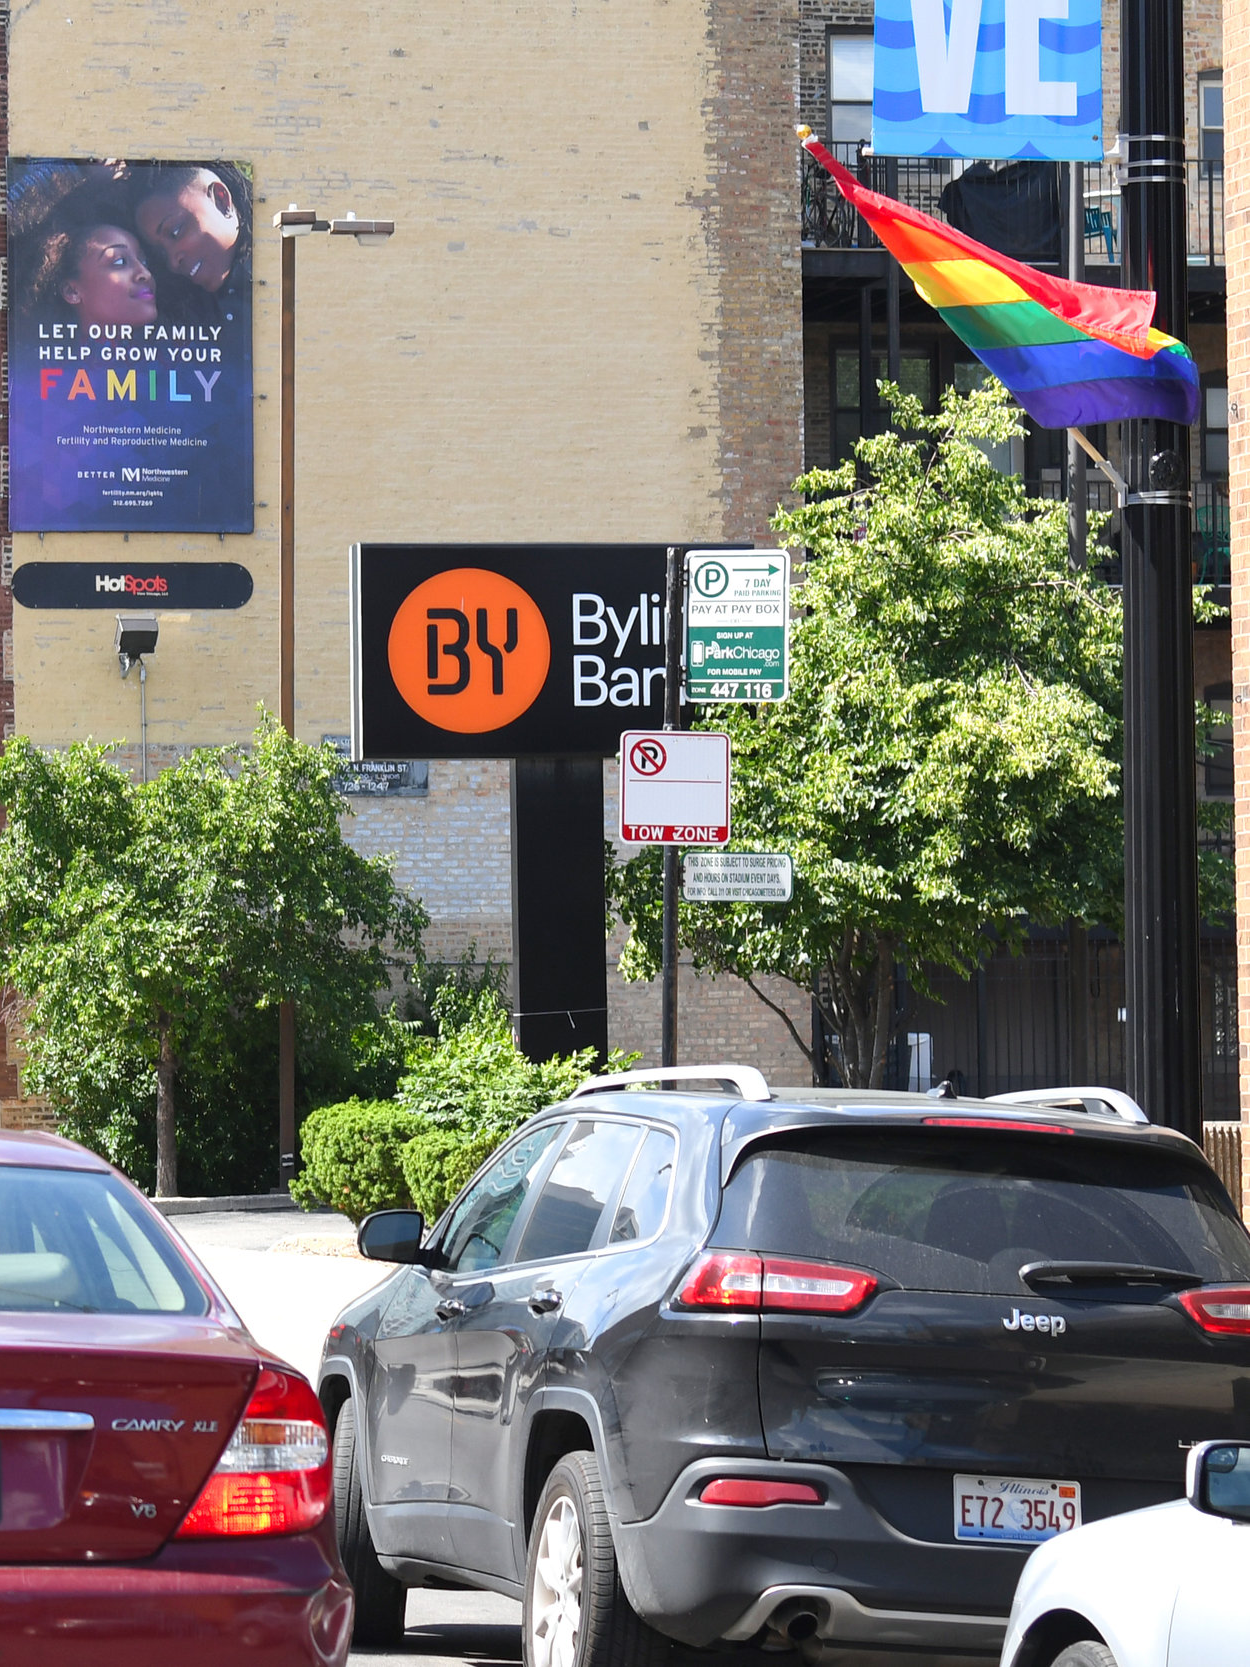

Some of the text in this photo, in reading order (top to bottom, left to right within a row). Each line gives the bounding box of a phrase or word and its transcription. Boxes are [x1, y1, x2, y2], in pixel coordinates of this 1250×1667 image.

[39, 324, 222, 340] LET OUR FAMILY
[39, 346, 222, 362] HELP GROW YOUR
[40, 368, 222, 402] FAMILY
[83, 425, 182, 435] Northwestern Medicine
[56, 436, 208, 446] Fertility and Reproductive Medicine
[77, 471, 116, 479] BETTER
[142, 468, 189, 476] Northwestern
[744, 579, 771, 588] 7 DAY
[752, 589, 782, 597] PARKING
[691, 604, 780, 614] PAY AT PAY BOX
[572, 593, 684, 658] Byli
[426, 607, 519, 695] BY
[705, 646, 780, 661] ParkChicago
[722, 668, 749, 676] MOBILE
[749, 668, 762, 676] PAY
[573, 654, 686, 707] Ban
[710, 683, 739, 697] 447
[744, 683, 772, 698] 116
[629, 826, 719, 841] TOW ZONE
[688, 856, 786, 868] THIS ZONE IS SUBJECT TO SURGE PRICING
[693, 873, 703, 883] AND
[704, 873, 720, 883] HOURS
[721, 873, 729, 883] ON
[729, 873, 750, 883] STADIUM
[750, 873, 766, 883] EVENT
[687, 887, 696, 897] FOR
[708, 887, 718, 897] CALL
[732, 887, 742, 897] VISIT
[1002, 1308, 1067, 1337] Jeep
[111, 1418, 219, 1433] CAMRY XLE
[999, 1481, 1050, 1496] Illinois
[130, 1503, 157, 1518] V6
[961, 1494, 1076, 1533] E72 3549
